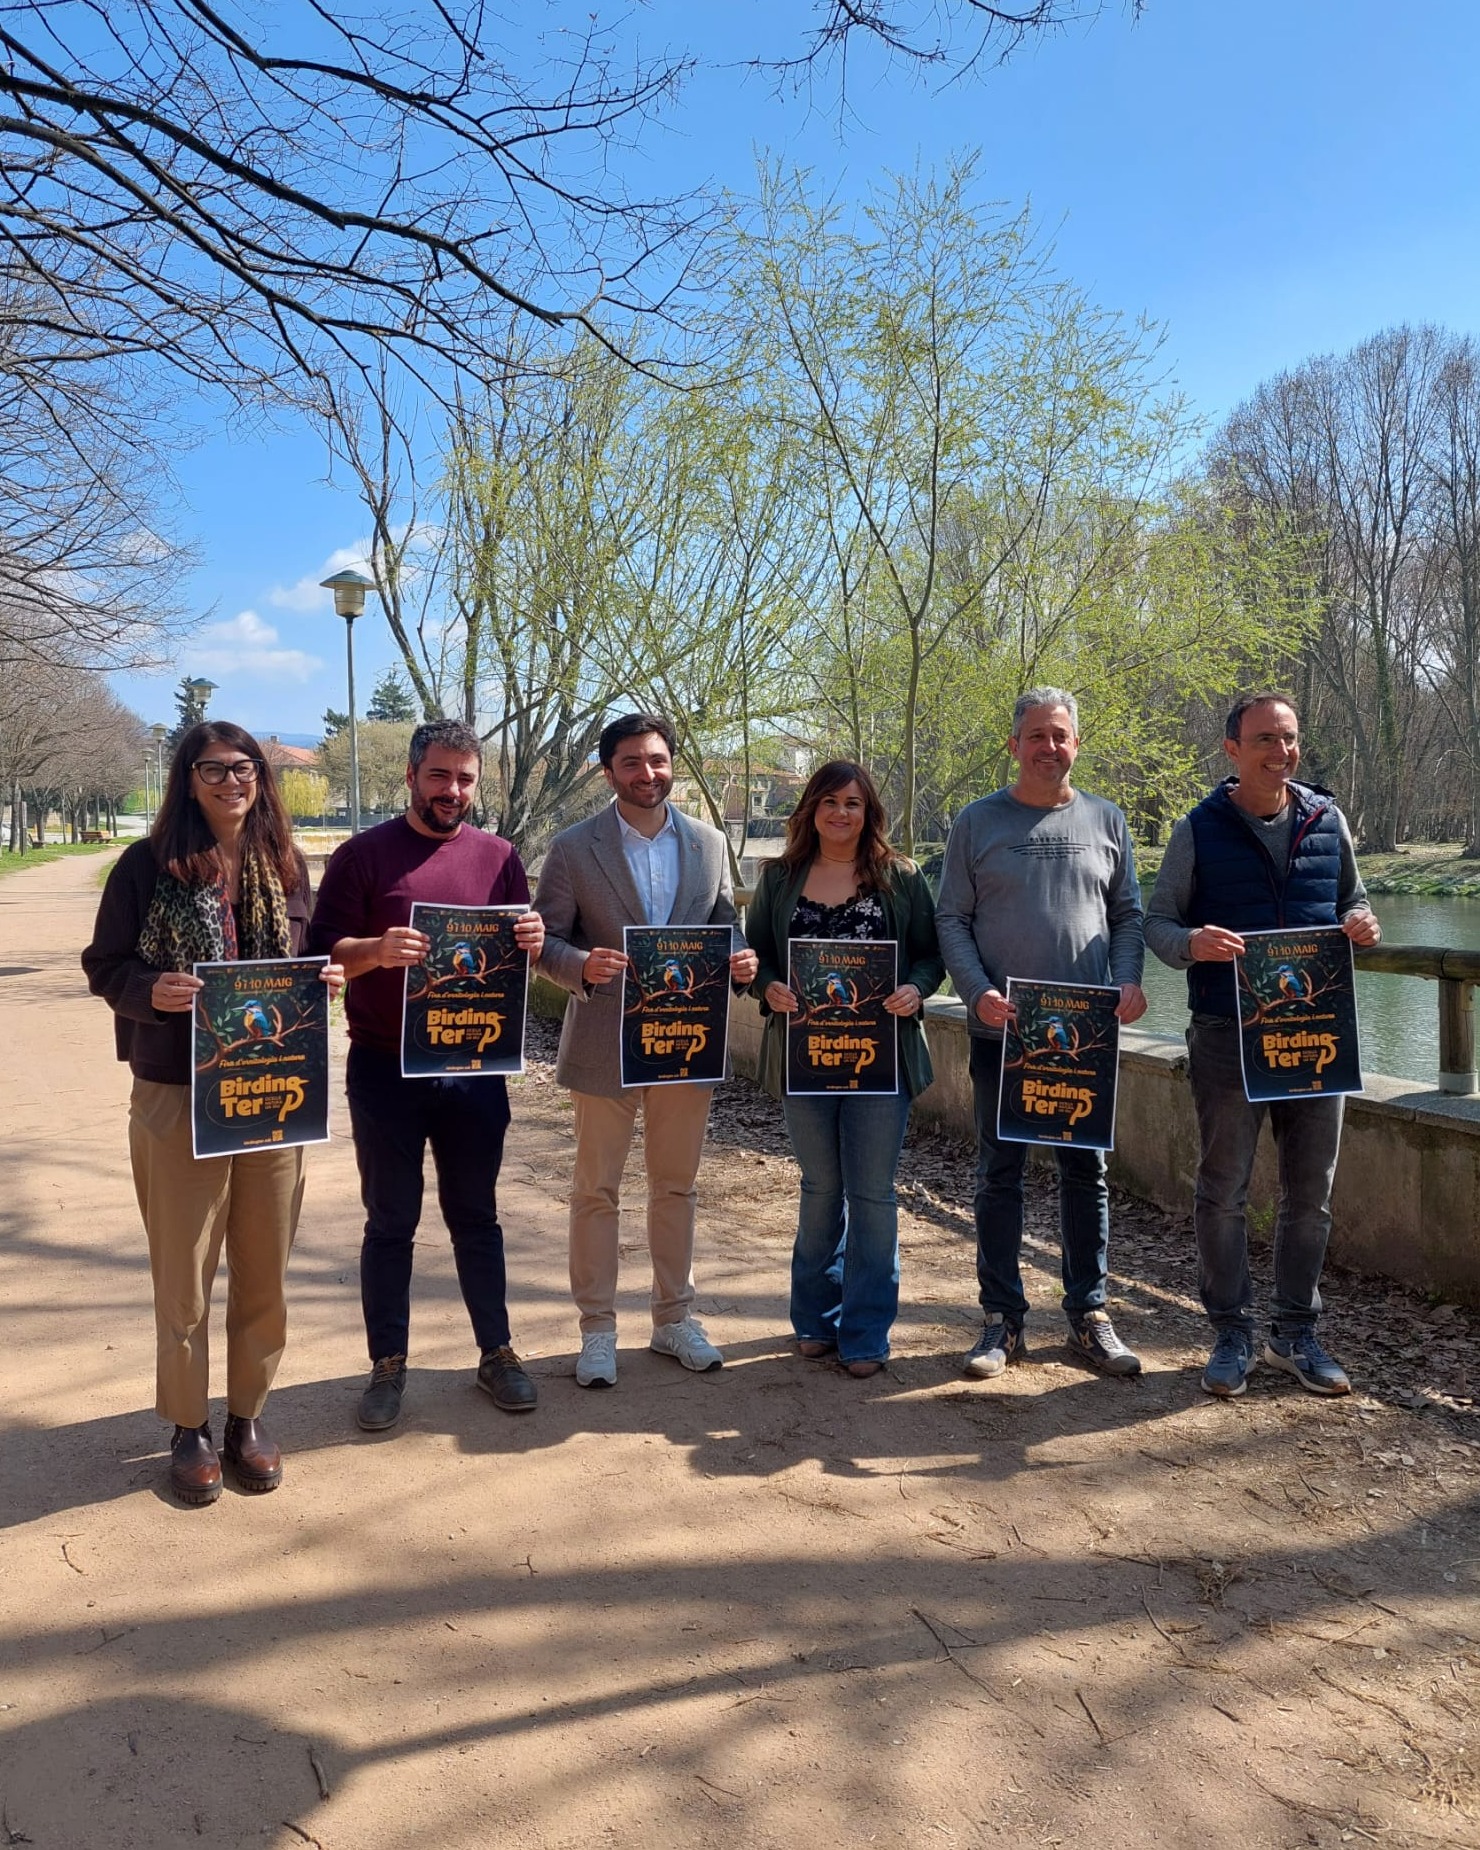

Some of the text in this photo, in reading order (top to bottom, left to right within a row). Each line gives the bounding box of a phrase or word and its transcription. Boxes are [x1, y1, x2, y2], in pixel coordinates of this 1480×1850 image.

[473, 924, 499, 933] MAIG
[680, 941, 703, 950] MAIG
[1292, 944, 1318, 955] MAIG
[841, 956, 866, 965] MAIG
[234, 980, 241, 990] 9
[249, 978, 262, 989] 10
[264, 976, 293, 988] MAIG
[1065, 999, 1090, 1010] MAIG
[426, 1026, 465, 1044] Ter
[427, 1008, 507, 1053] Birding
[641, 1020, 712, 1061] Birding
[641, 1037, 674, 1055] Ter
[808, 1034, 880, 1074] Birding
[808, 1049, 843, 1066] Ter
[1262, 1030, 1341, 1074] Birding
[1264, 1049, 1302, 1069] Ter
[220, 1073, 310, 1122] Birding
[220, 1096, 263, 1117] Ter
[1022, 1079, 1098, 1126] Birding
[1022, 1094, 1058, 1115] Ter
